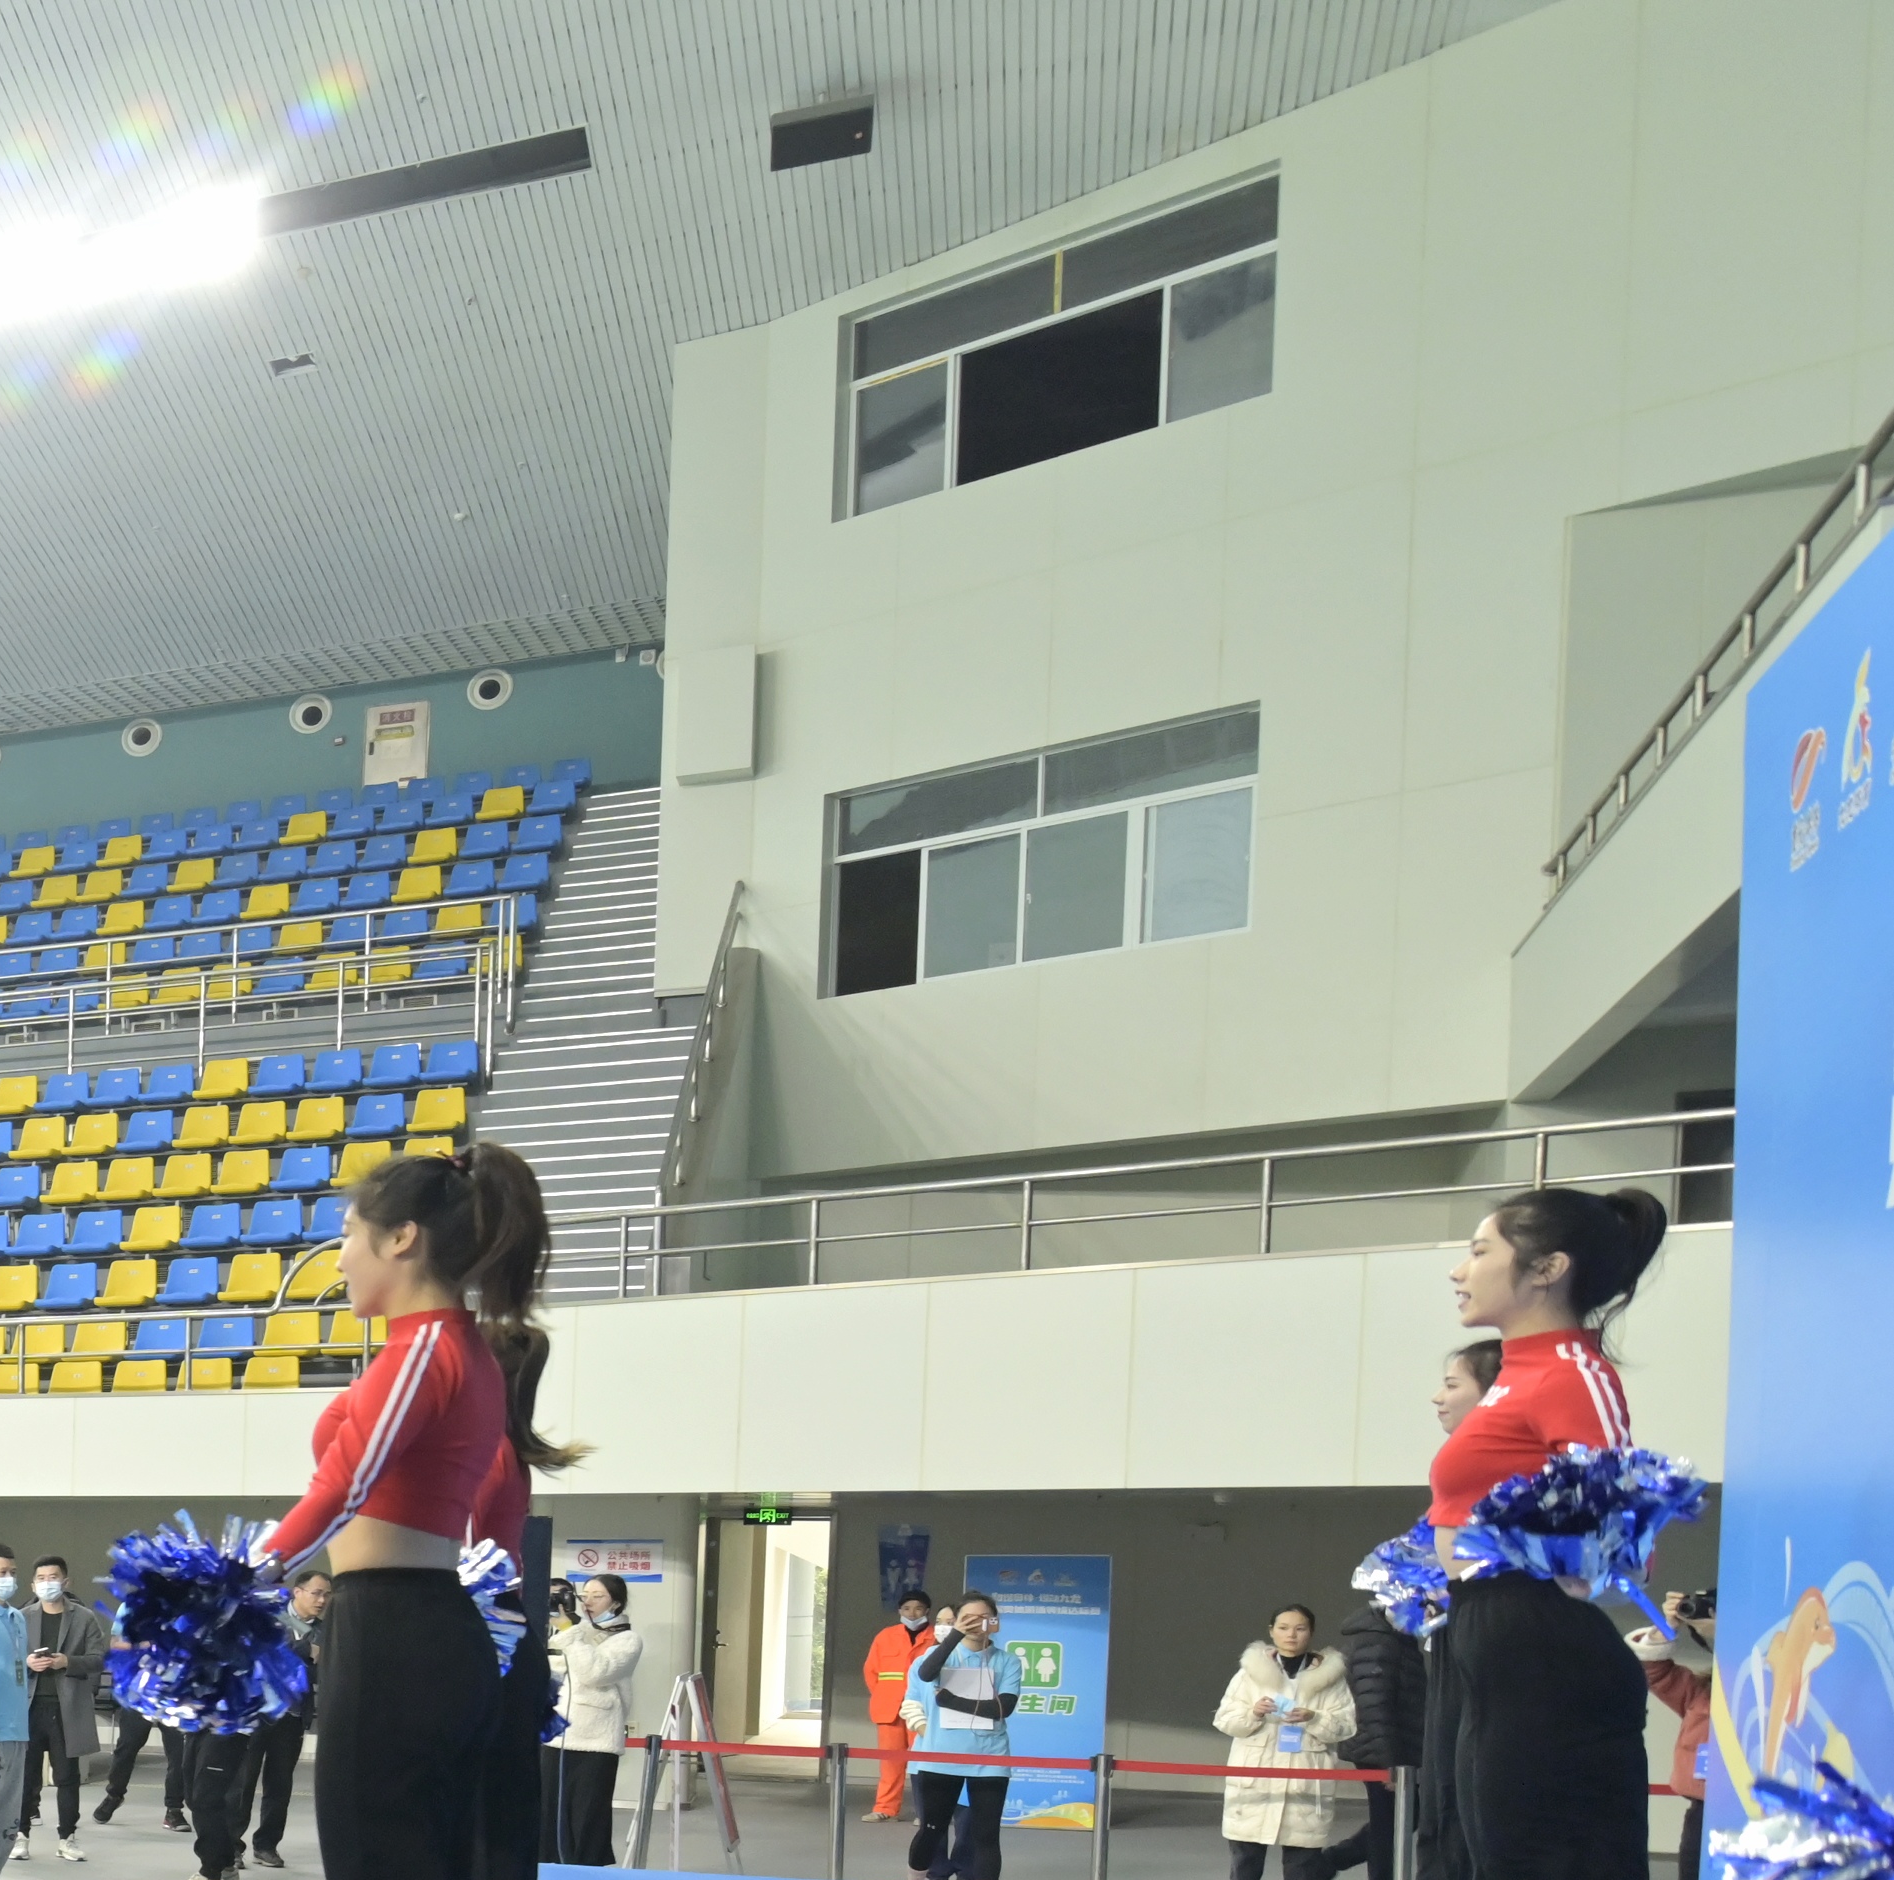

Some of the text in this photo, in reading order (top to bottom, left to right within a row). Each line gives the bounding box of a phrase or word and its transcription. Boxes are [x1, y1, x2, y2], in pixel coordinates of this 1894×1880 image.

[607, 1551, 651, 1561] 公共场所
[607, 1561, 651, 1571] 禁止吸烟
[1016, 1693, 1077, 1715] 生间
